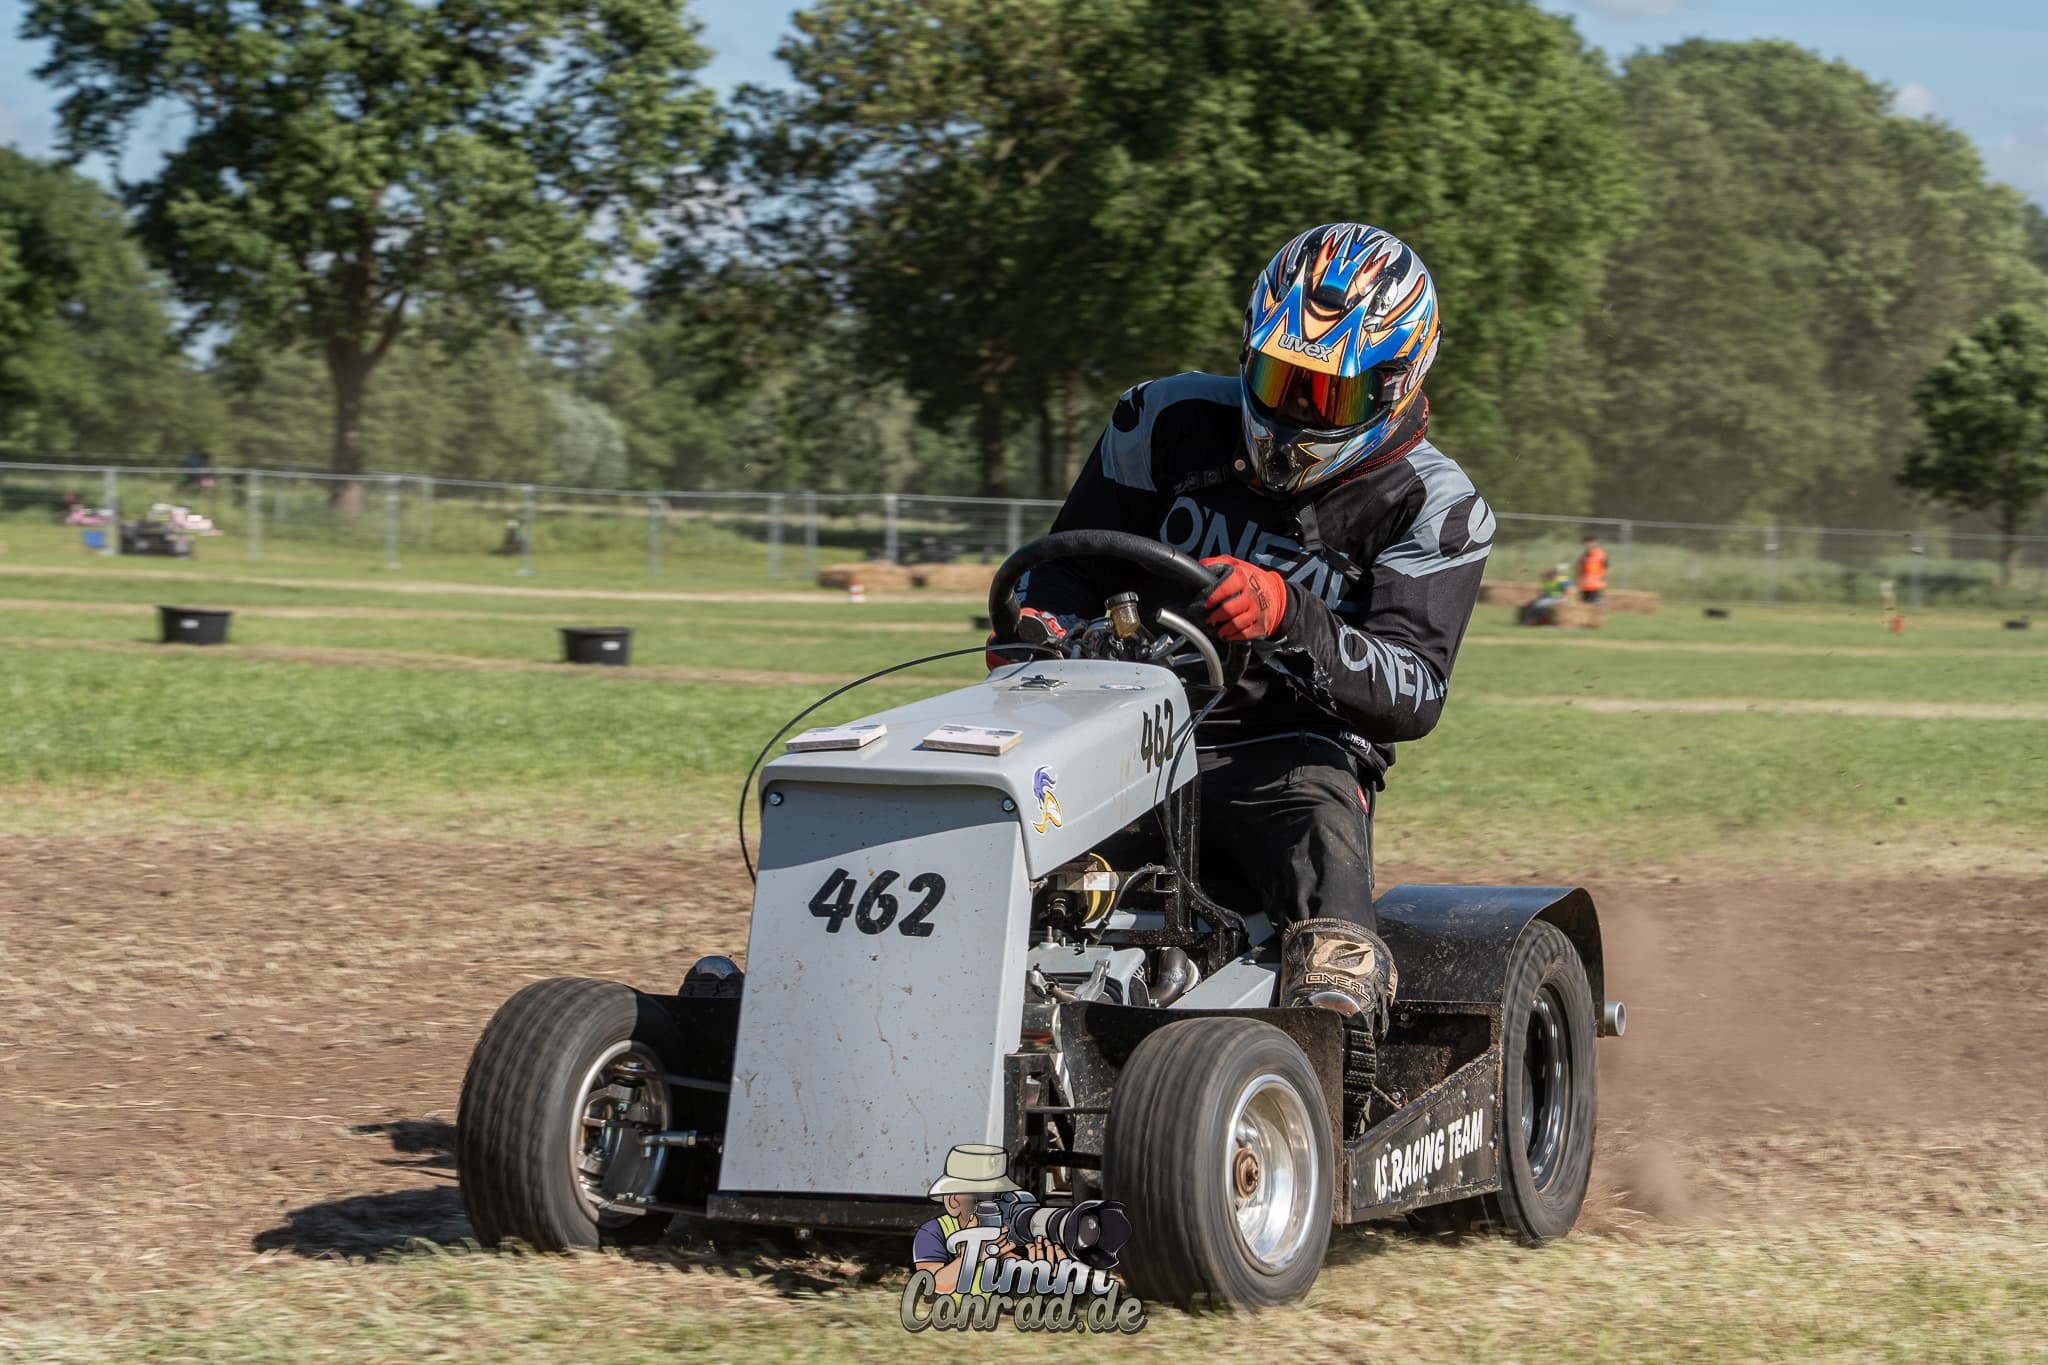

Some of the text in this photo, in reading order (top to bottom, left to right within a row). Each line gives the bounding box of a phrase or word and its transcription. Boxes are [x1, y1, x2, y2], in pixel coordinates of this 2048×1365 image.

[1278, 333, 1334, 362] uvex
[1141, 698, 1174, 774] 462
[808, 868, 946, 937] 462
[1391, 1128, 1445, 1193] RACING
[1447, 1107, 1483, 1164] TEAM
